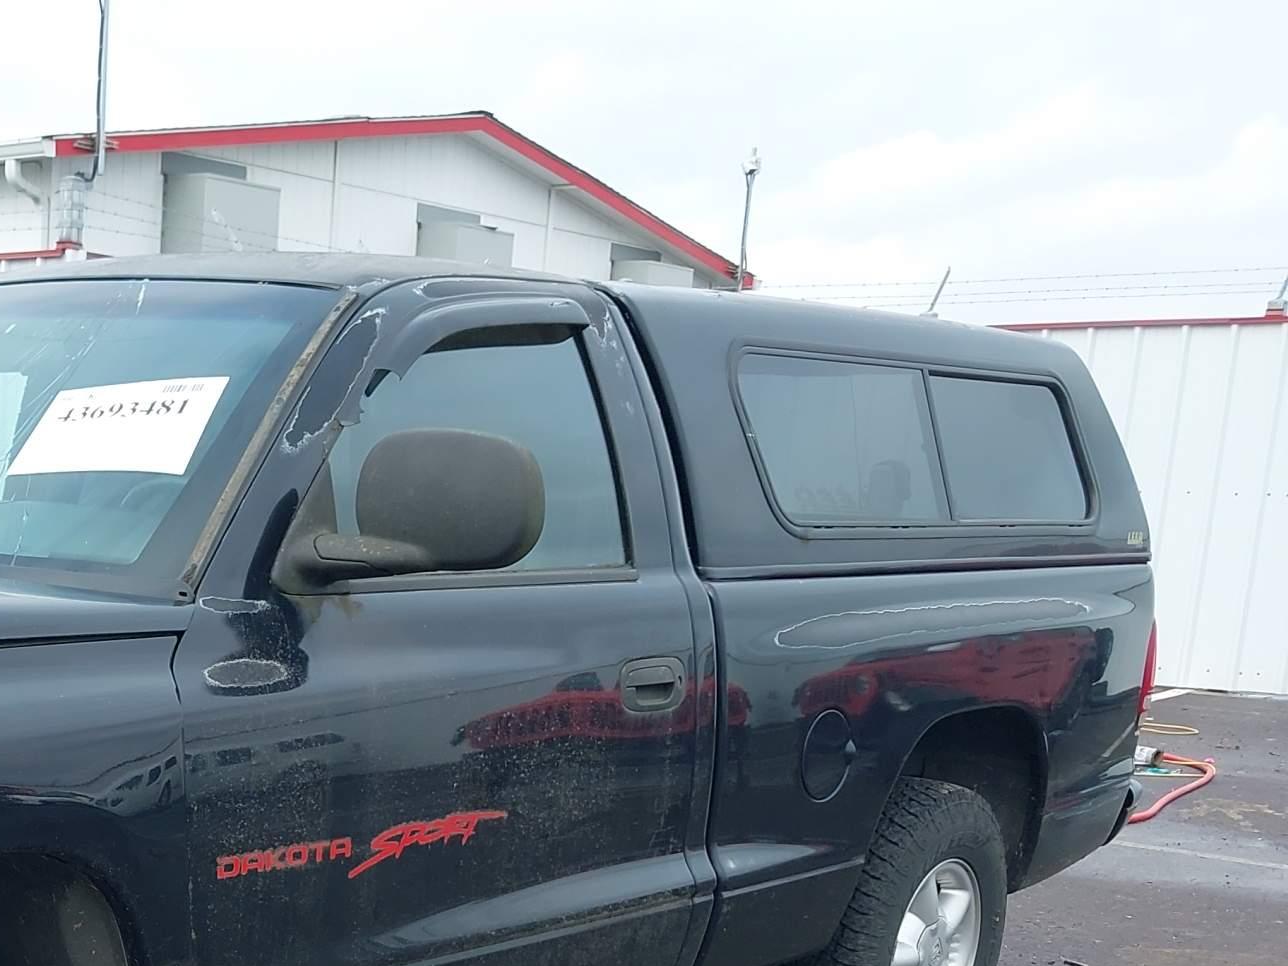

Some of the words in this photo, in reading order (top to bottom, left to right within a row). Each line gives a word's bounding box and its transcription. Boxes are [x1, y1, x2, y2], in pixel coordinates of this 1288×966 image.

[57, 398, 190, 423] 43693481
[216, 837, 353, 880] DAKOTA
[348, 810, 508, 880] SPORT
